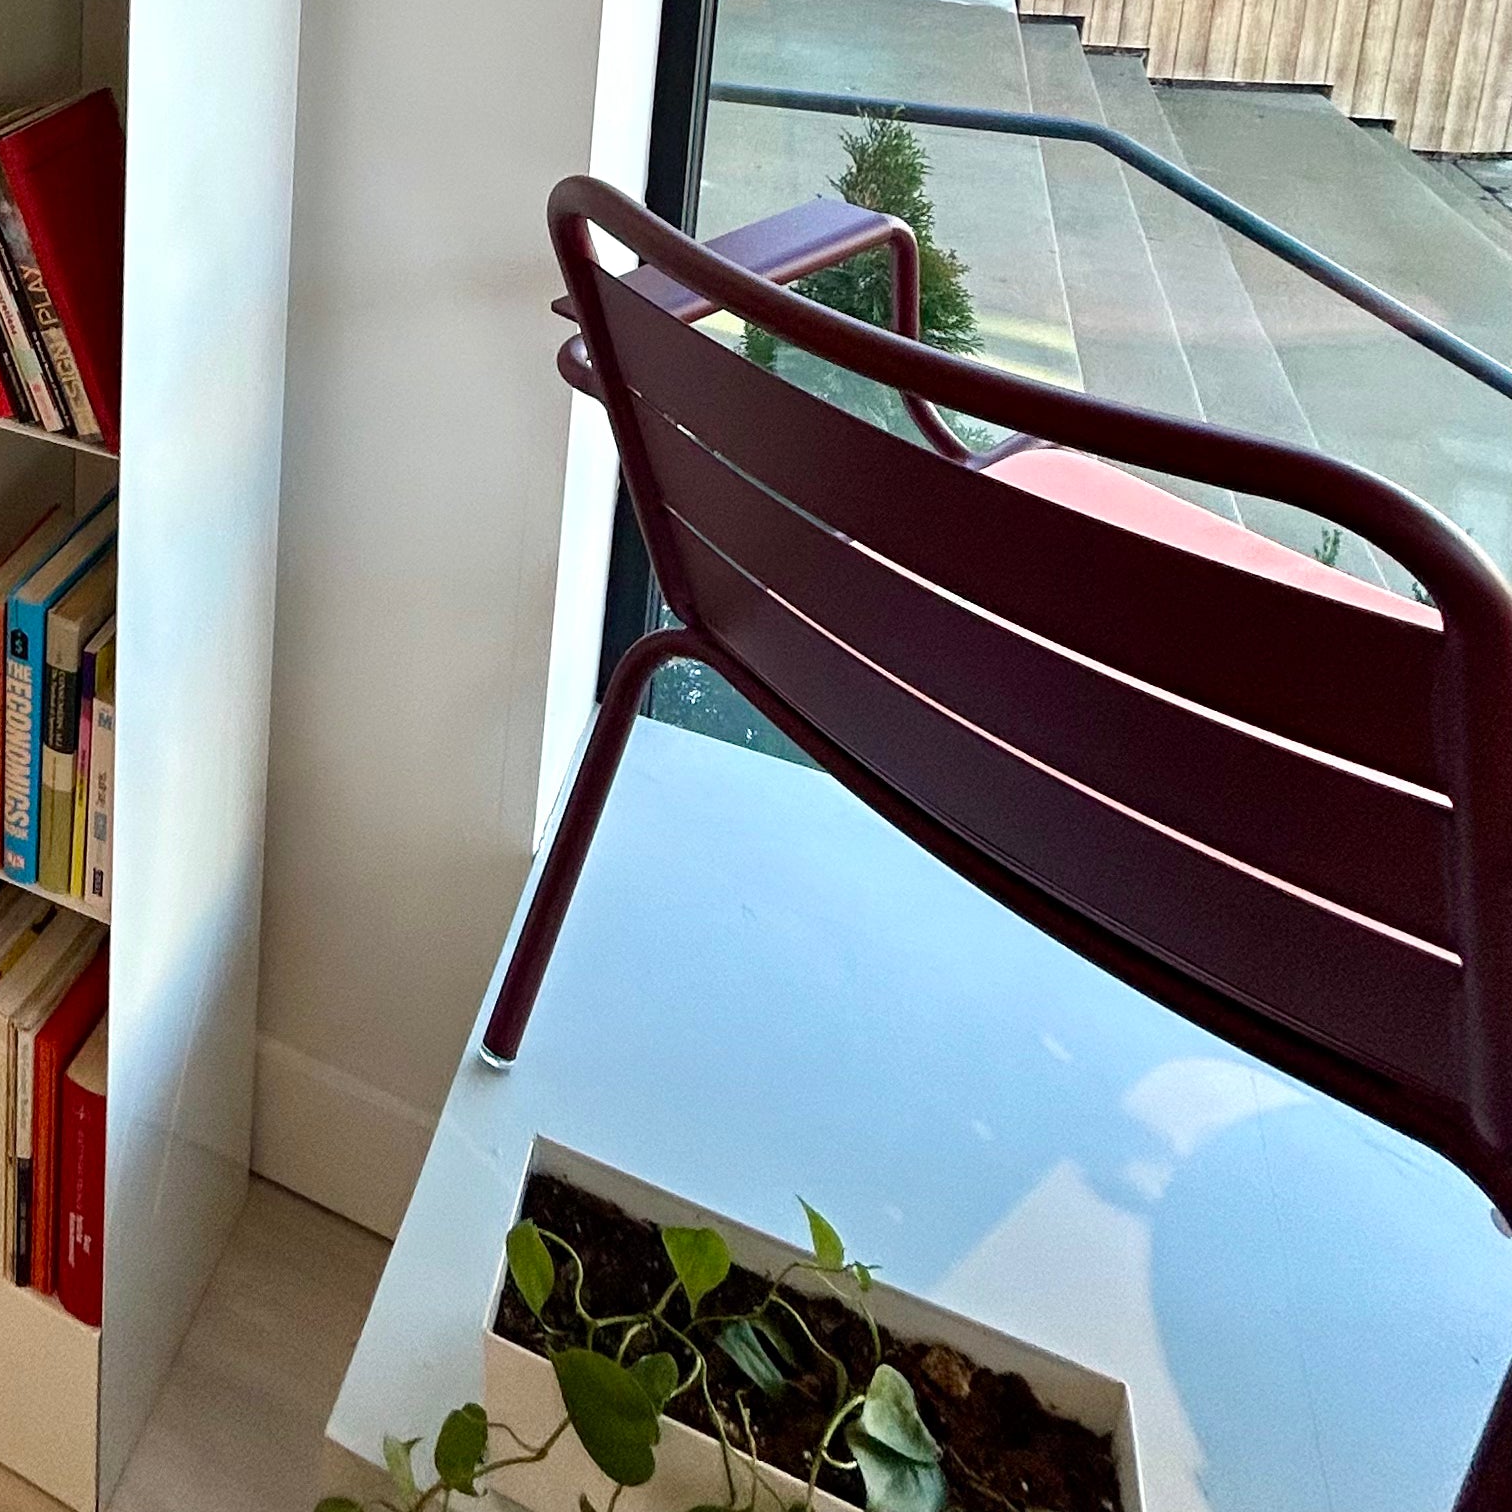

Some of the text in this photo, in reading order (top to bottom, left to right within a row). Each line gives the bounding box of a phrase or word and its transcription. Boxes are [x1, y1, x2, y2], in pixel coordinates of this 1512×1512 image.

[20, 264, 59, 325] PLAY
[7, 659, 32, 682] THE
[4, 674, 33, 827] ECONOMICS
